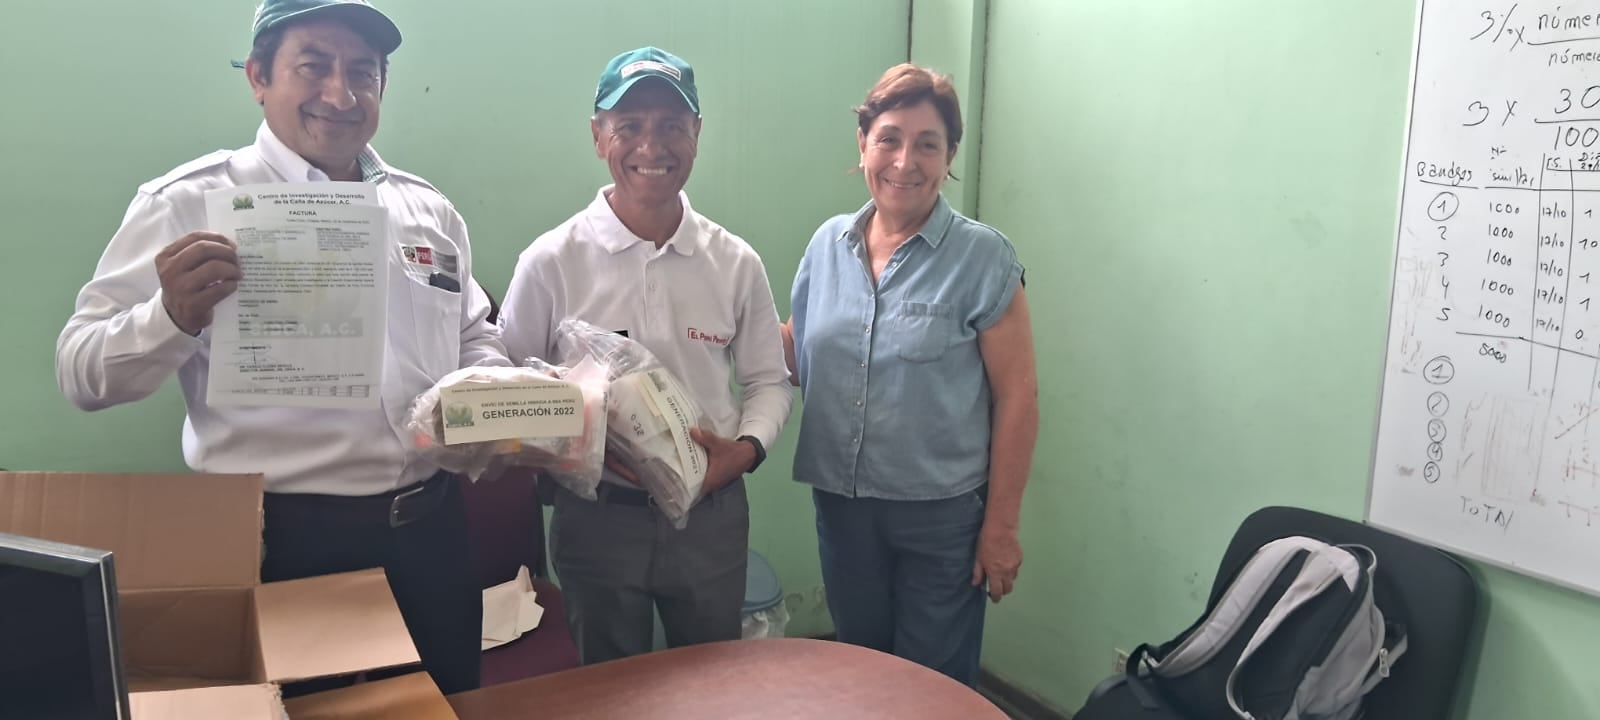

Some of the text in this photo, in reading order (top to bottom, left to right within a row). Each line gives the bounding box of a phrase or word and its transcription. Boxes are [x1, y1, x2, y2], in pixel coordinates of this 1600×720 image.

[1462, 100, 1490, 126] 3
[289, 192, 329, 200] Investigación
[1437, 226, 1447, 241] 2
[1488, 224, 1514, 239] 1000
[1486, 249, 1512, 267] 1000
[1481, 278, 1514, 296] 1000
[1478, 304, 1511, 328] 1000
[482, 405, 575, 419] GENERACIÓN 2022
